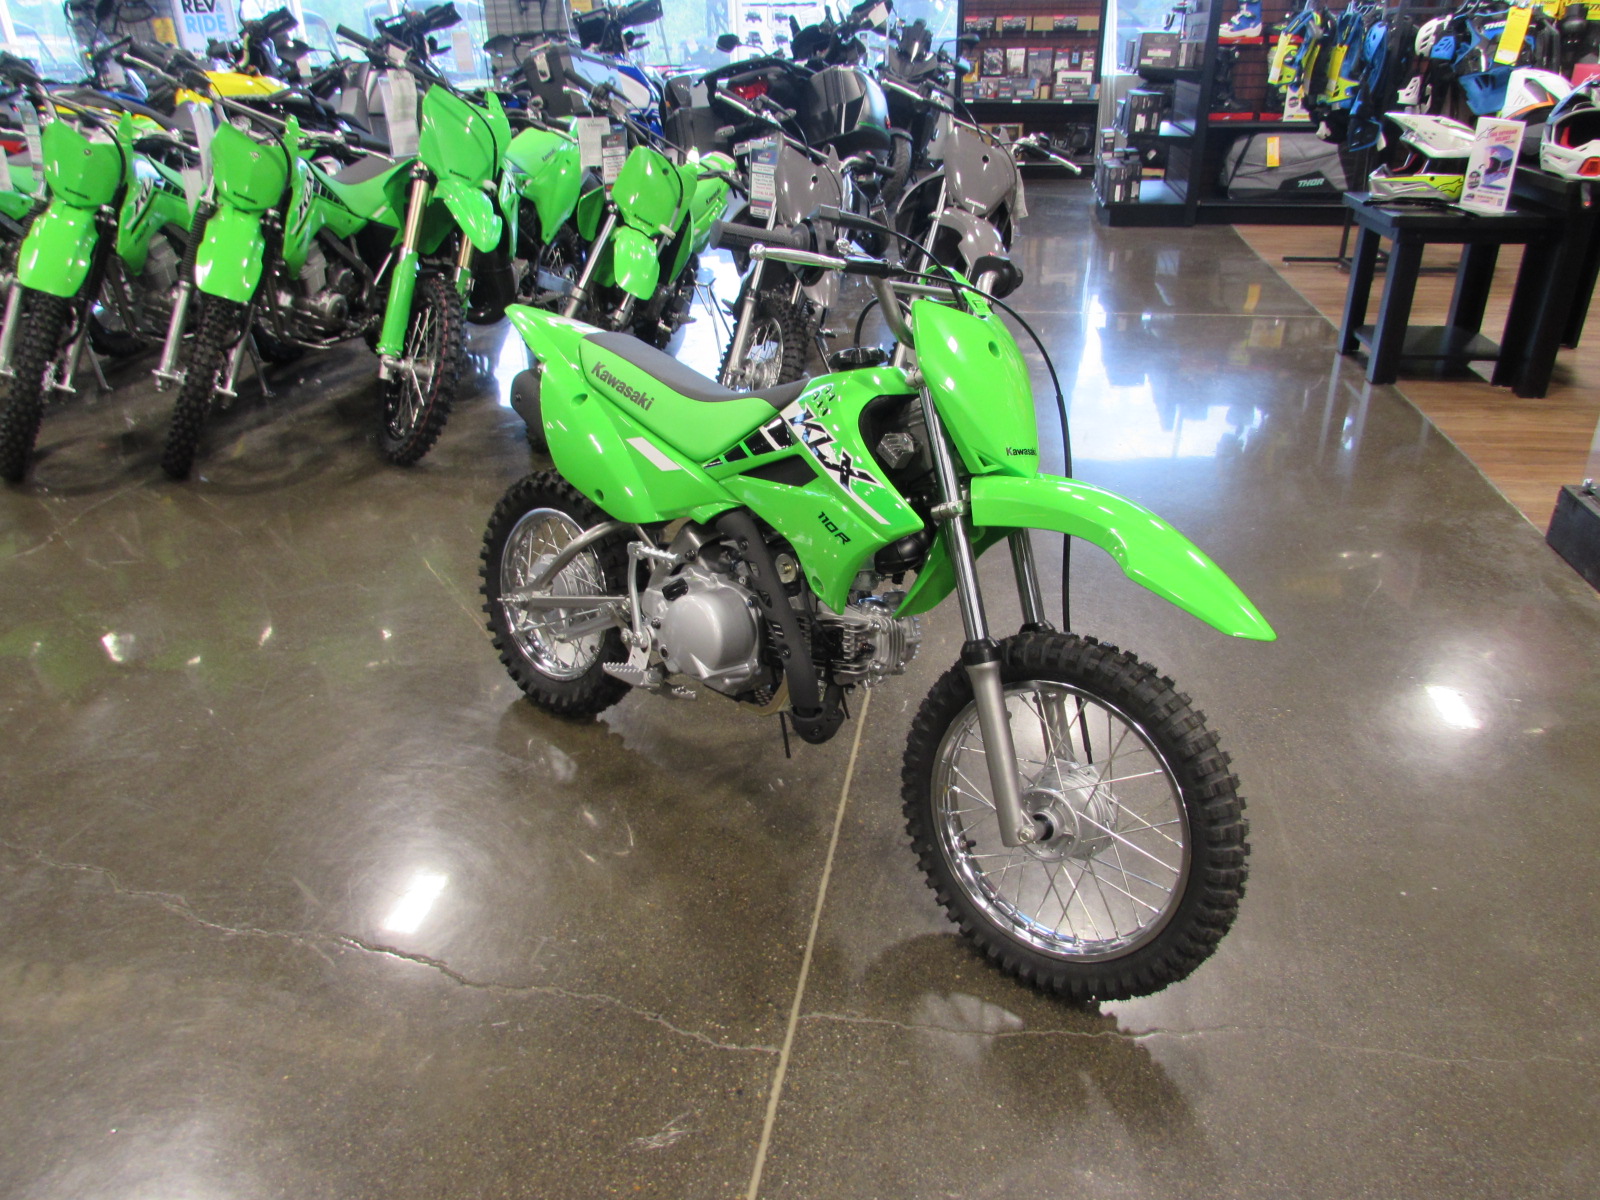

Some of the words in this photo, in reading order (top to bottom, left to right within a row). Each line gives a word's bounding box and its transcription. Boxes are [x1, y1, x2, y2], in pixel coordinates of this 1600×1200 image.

[184, 14, 228, 34] RIDE
[1297, 178, 1325, 188] THOR
[591, 361, 655, 411] Kawasaki
[787, 404, 885, 492] KLX
[1006, 446, 1037, 456] Kawasaki
